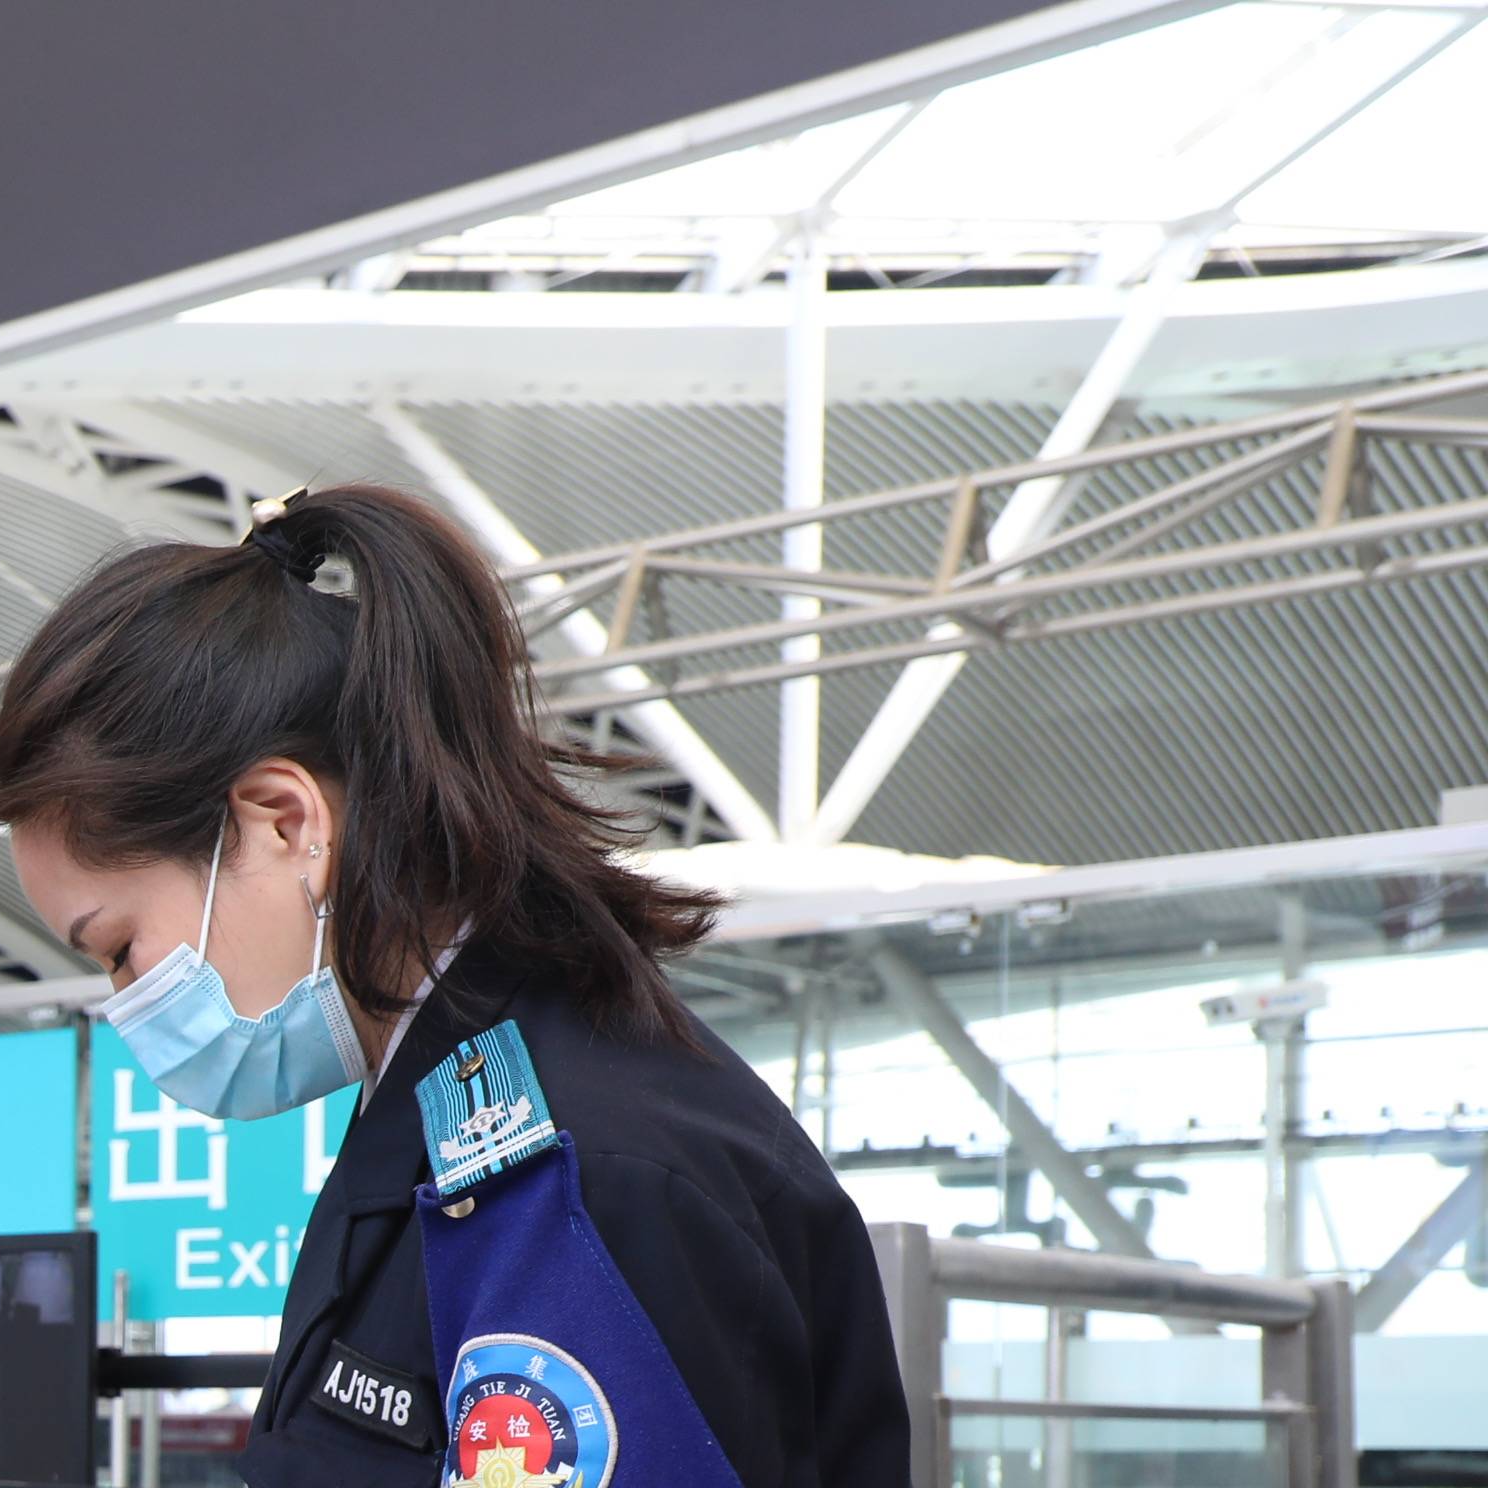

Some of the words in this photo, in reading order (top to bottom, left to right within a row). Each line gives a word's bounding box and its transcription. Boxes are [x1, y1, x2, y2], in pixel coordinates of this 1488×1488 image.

[323, 1360, 412, 1427] AJ1518
[479, 1381, 506, 1397] TIE
[514, 1383, 531, 1399] JI
[536, 1397, 566, 1441] TUAN
[469, 1414, 531, 1442] 安检
